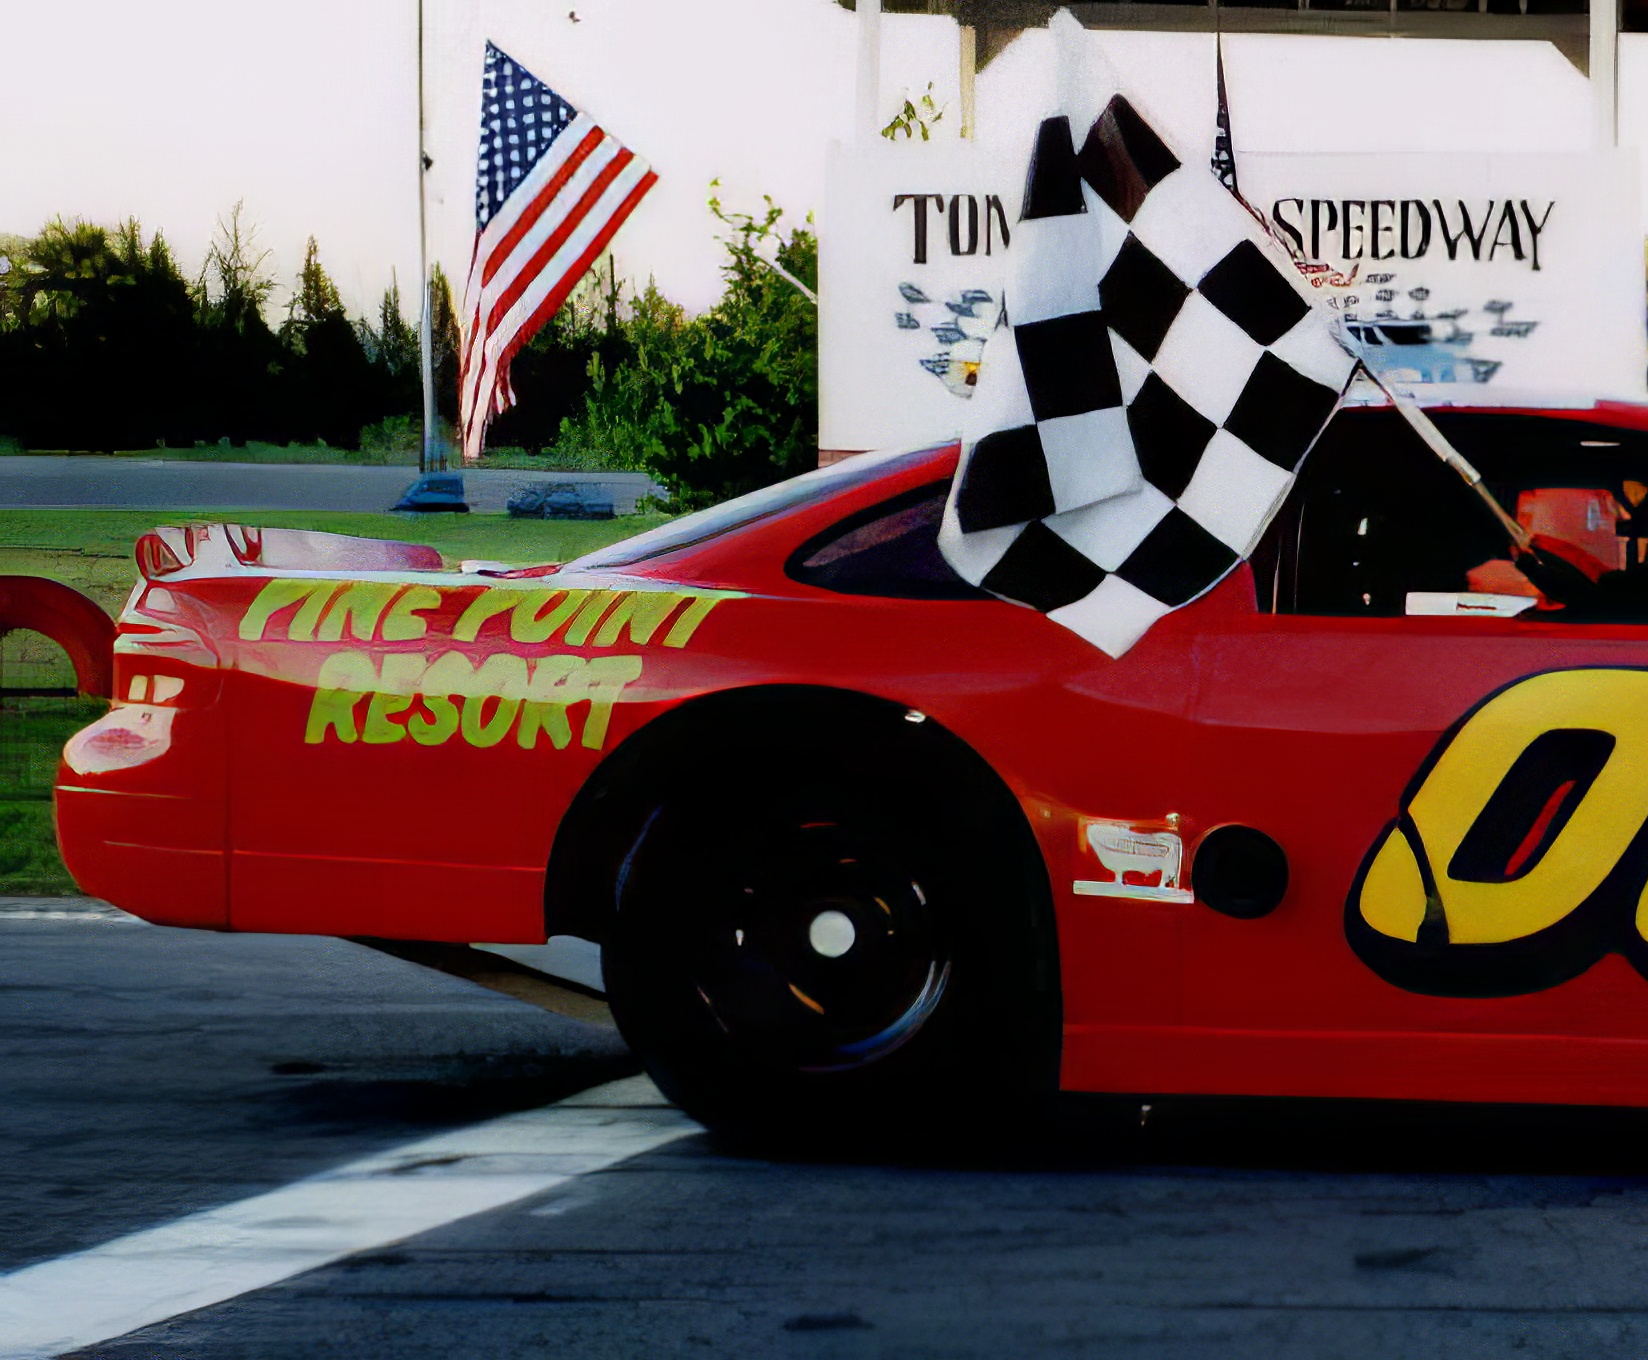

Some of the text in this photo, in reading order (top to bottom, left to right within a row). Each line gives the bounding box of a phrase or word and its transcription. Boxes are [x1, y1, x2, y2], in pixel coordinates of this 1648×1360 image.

[1272, 198, 1556, 271] SPEEDWAY
[238, 578, 723, 650] PINE POINT
[304, 651, 643, 750] RESORT
